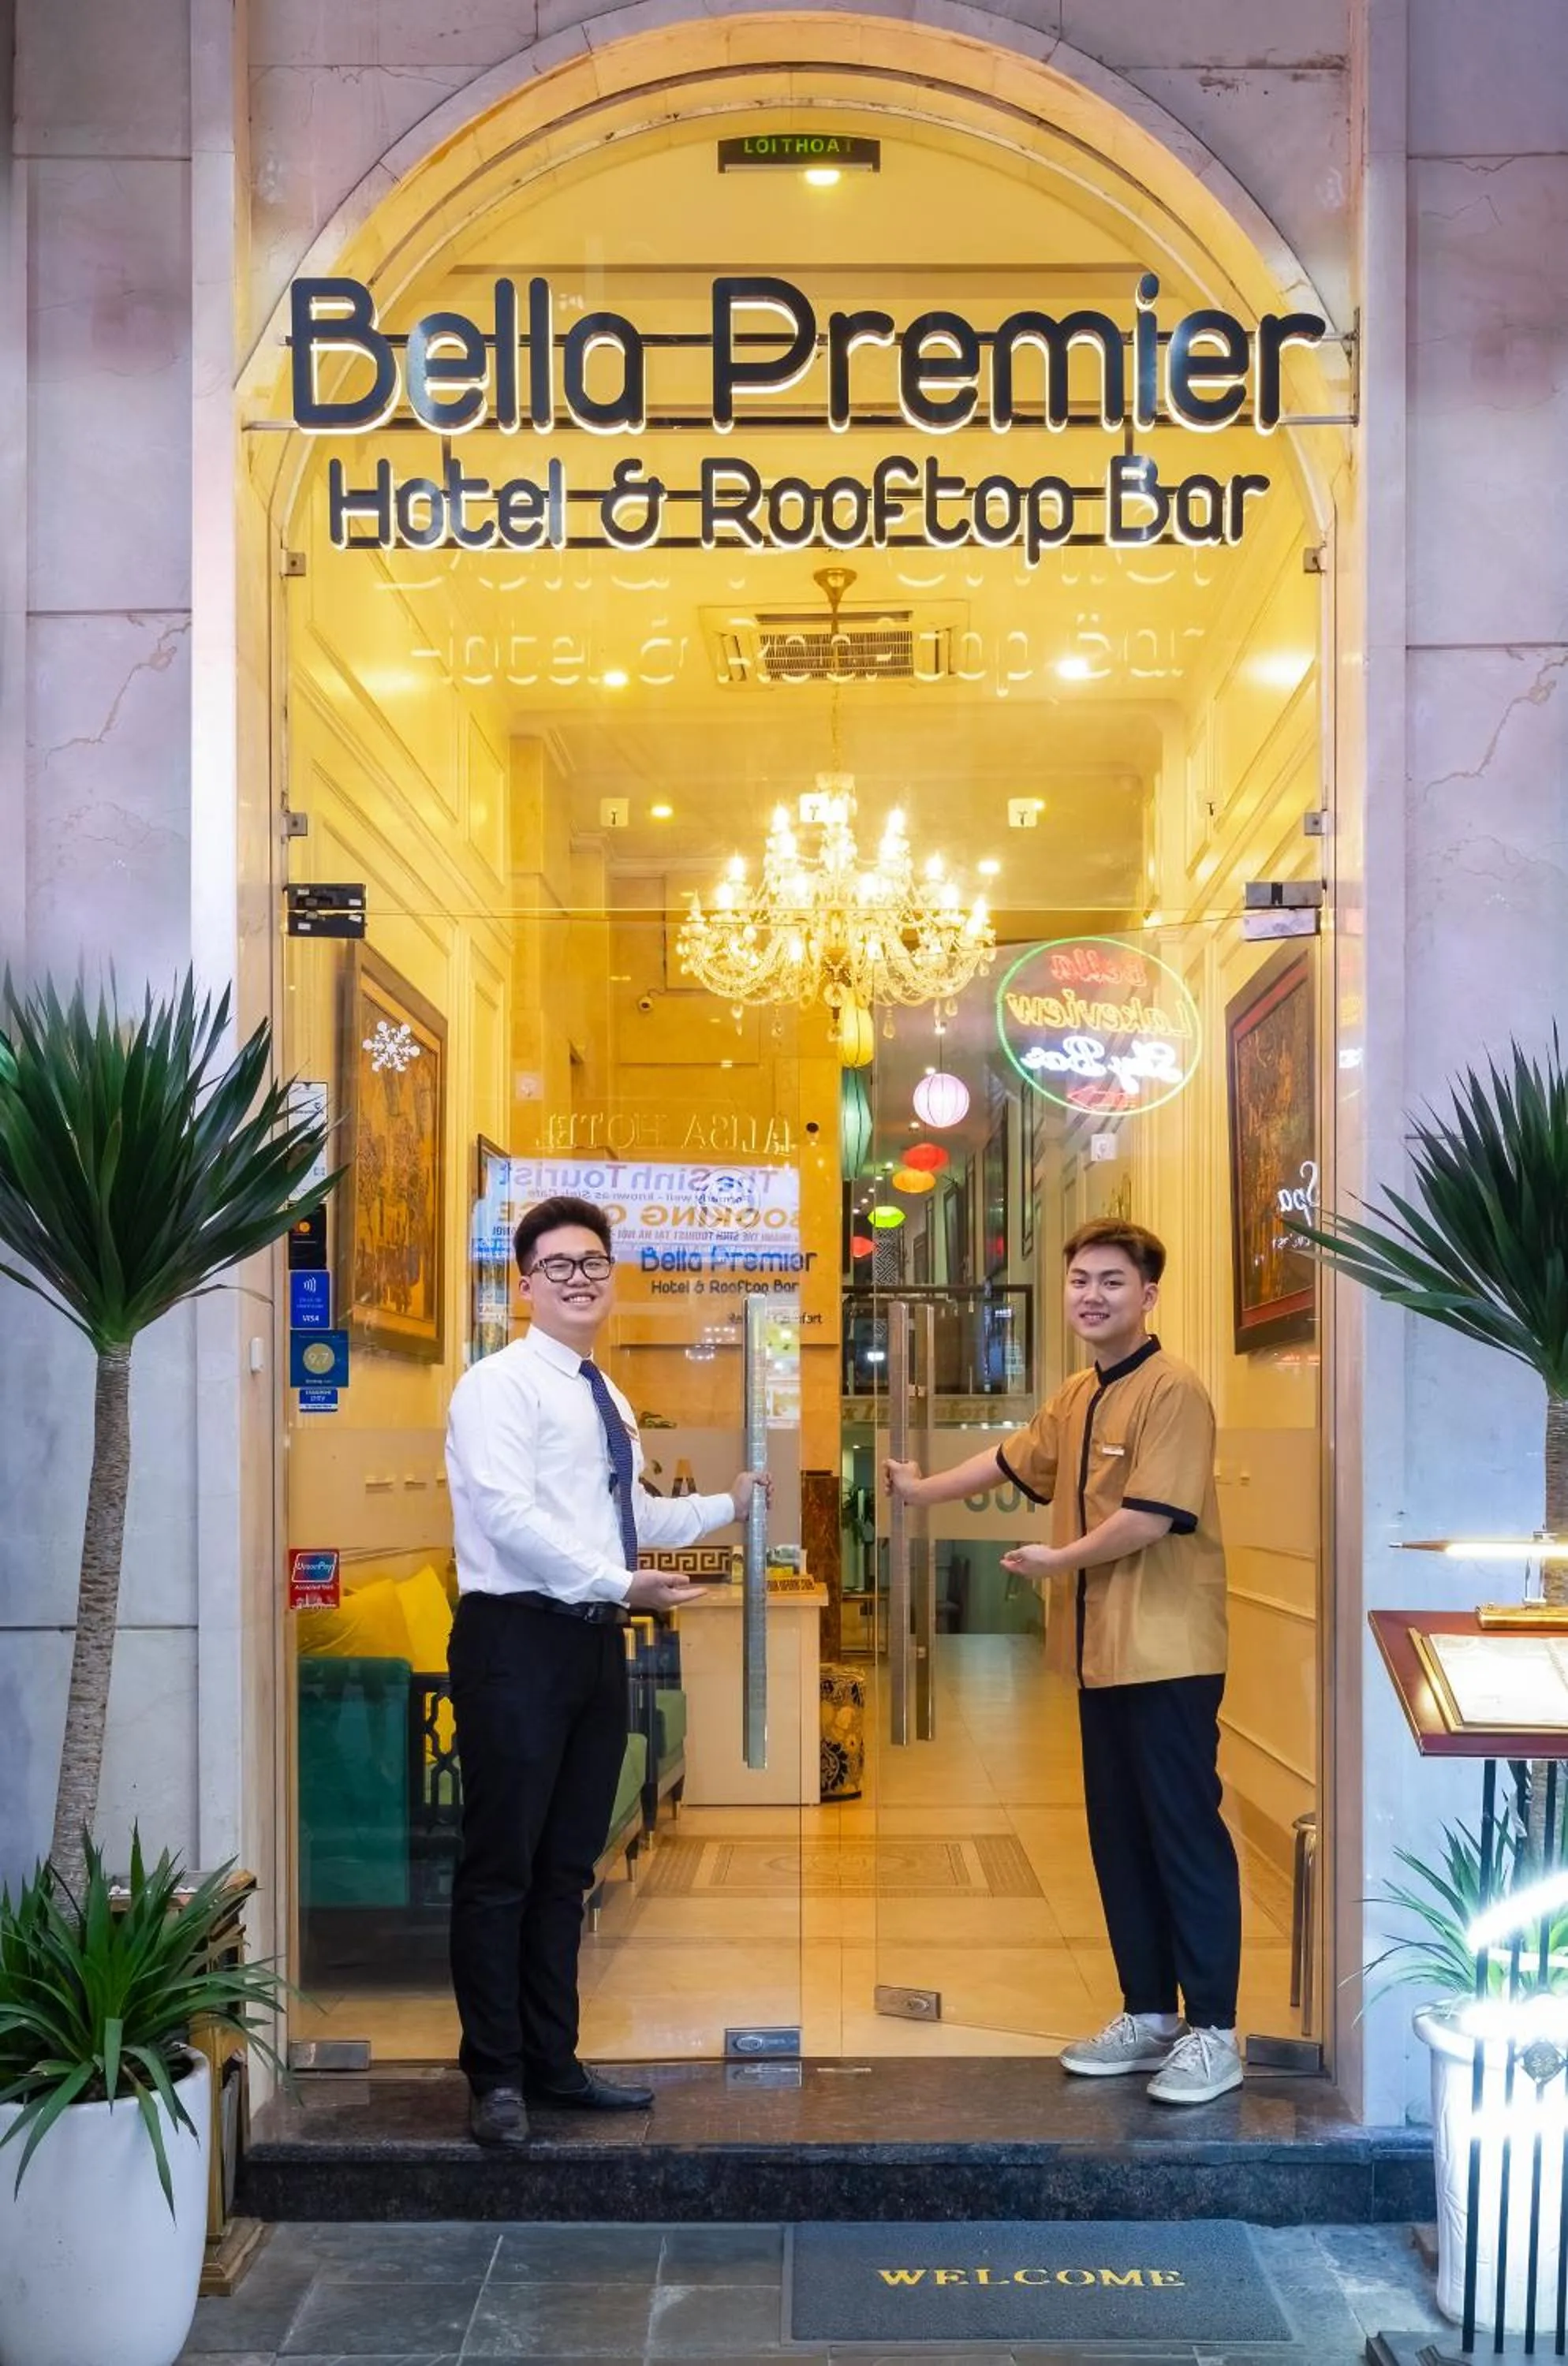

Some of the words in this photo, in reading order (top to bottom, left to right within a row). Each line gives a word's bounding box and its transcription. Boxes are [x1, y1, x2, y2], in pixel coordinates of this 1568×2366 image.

[290, 278, 646, 434] Bella
[711, 273, 1326, 434] Premier
[329, 457, 566, 550] Hotel
[601, 458, 666, 549] &
[701, 455, 1074, 569] Rooftop
[1107, 455, 1270, 548] Bar
[640, 1246, 702, 1271] Bella
[711, 1245, 818, 1271] Premier
[651, 1279, 690, 1294] Hotel
[711, 1279, 769, 1296] Rooftop
[774, 1279, 800, 1293] Bar
[878, 2268, 1186, 2286] WELCOME
